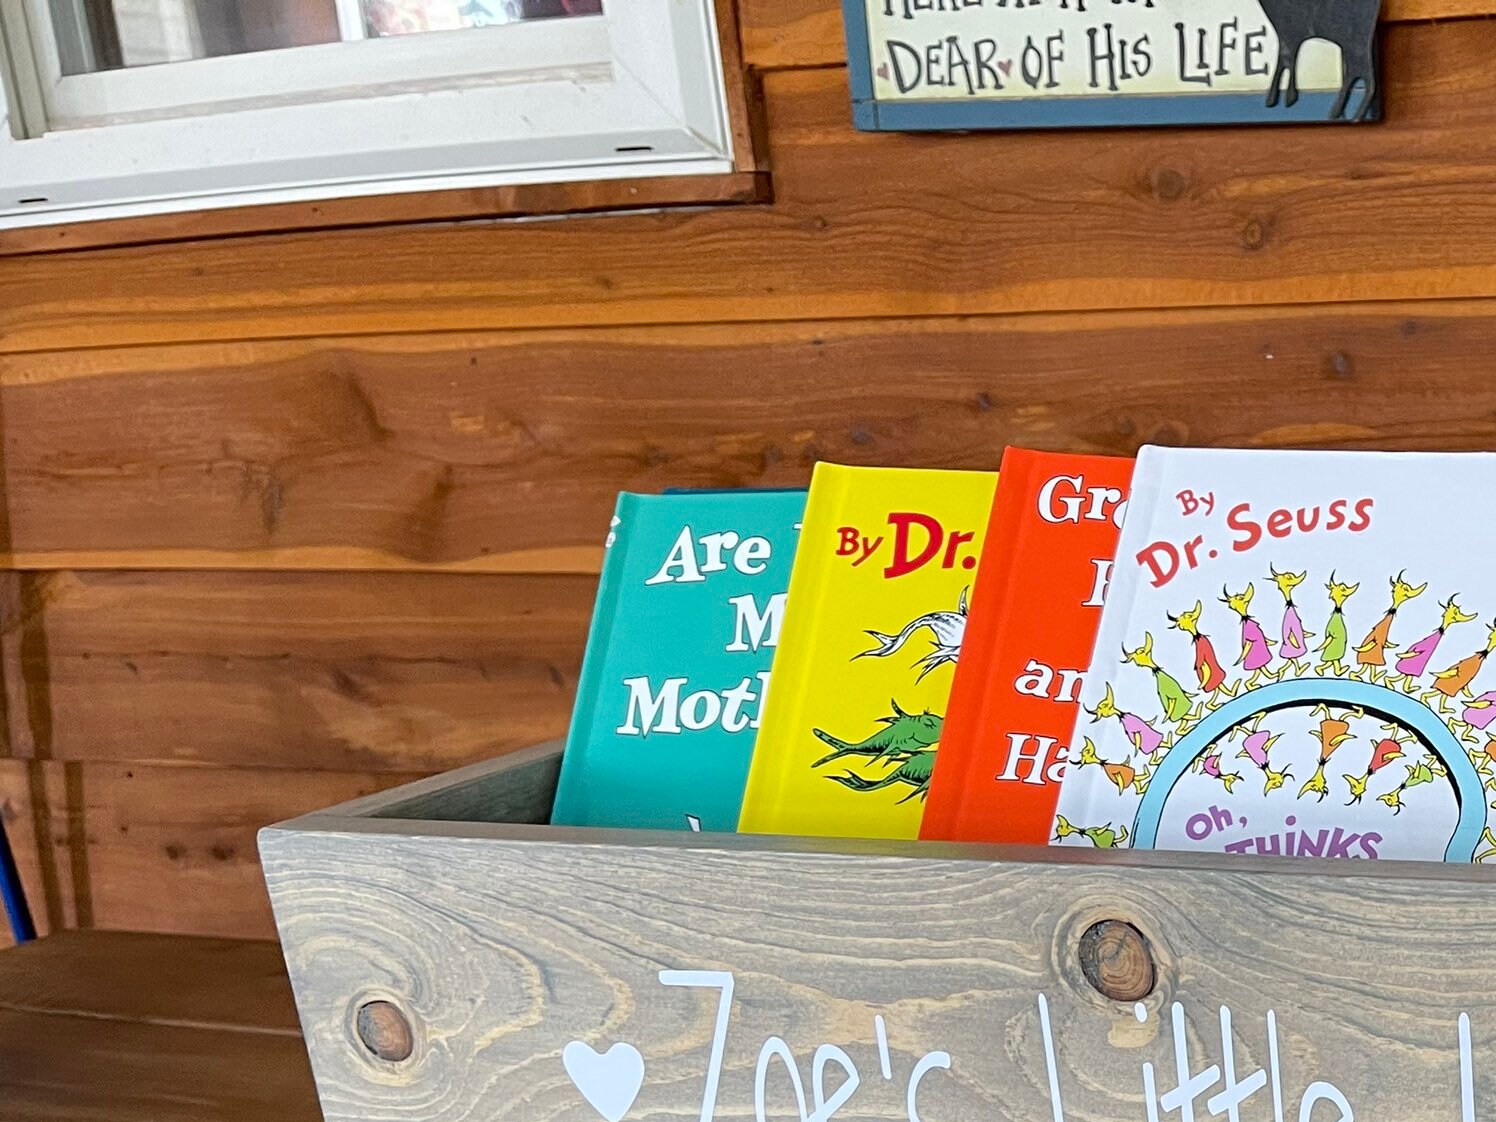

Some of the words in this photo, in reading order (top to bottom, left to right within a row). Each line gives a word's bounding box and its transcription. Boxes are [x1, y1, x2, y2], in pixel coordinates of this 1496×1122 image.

[887, 36, 1004, 95] DEAR
[1021, 29, 1064, 89] OF
[1087, 23, 1152, 91] HIS
[1174, 16, 1269, 87] LIFE
[1175, 489, 1215, 517] By
[644, 524, 772, 586] Are
[835, 526, 885, 567] By
[884, 512, 977, 579] Dr.
[1135, 534, 1218, 588] Dr.
[1226, 498, 1374, 553] Seuss
[1185, 805, 1248, 841] Oh,
